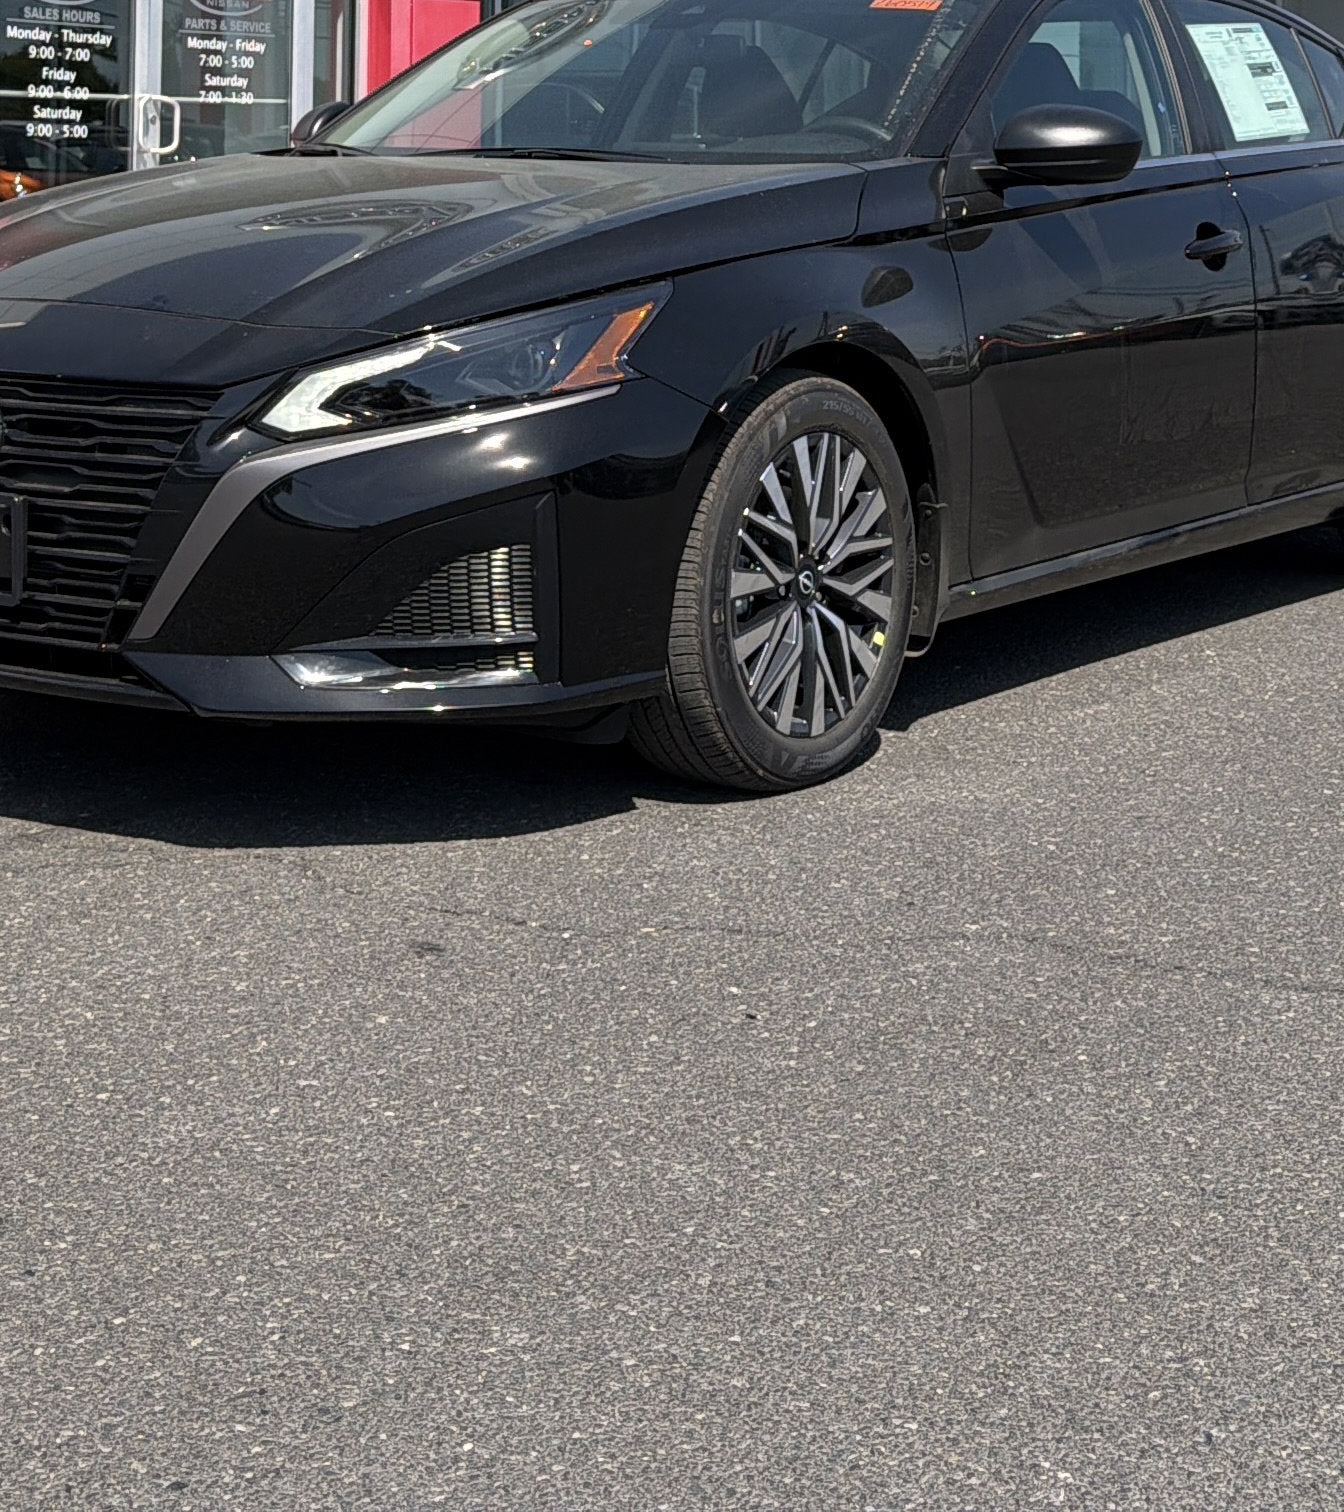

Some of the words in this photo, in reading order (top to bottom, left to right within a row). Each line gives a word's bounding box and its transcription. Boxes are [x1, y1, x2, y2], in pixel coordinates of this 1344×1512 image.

[24, 5, 59, 20] SALES
[62, 8, 100, 24] HOURS
[185, 17, 217, 31] PARTS
[220, 19, 228, 31] &
[230, 20, 271, 33] SERVICE
[6, 25, 52, 43] Monday
[61, 29, 112, 48] Thursday
[28, 45, 55, 59] 9:00
[65, 47, 90, 62] 7:00
[187, 36, 228, 53] Monday
[236, 39, 266, 55] Friday
[199, 54, 223, 68] 7:00
[231, 55, 254, 69] 5:00
[42, 67, 77, 84] Friday
[204, 73, 248, 89] Saturday
[28, 83, 54, 98] 9:00
[63, 86, 90, 100] 6:00
[199, 90, 222, 103] 7:00
[232, 91, 254, 105] 1:30
[33, 104, 83, 122] Saturday
[26, 123, 53, 138] 9:00
[63, 125, 88, 139] 5:00
